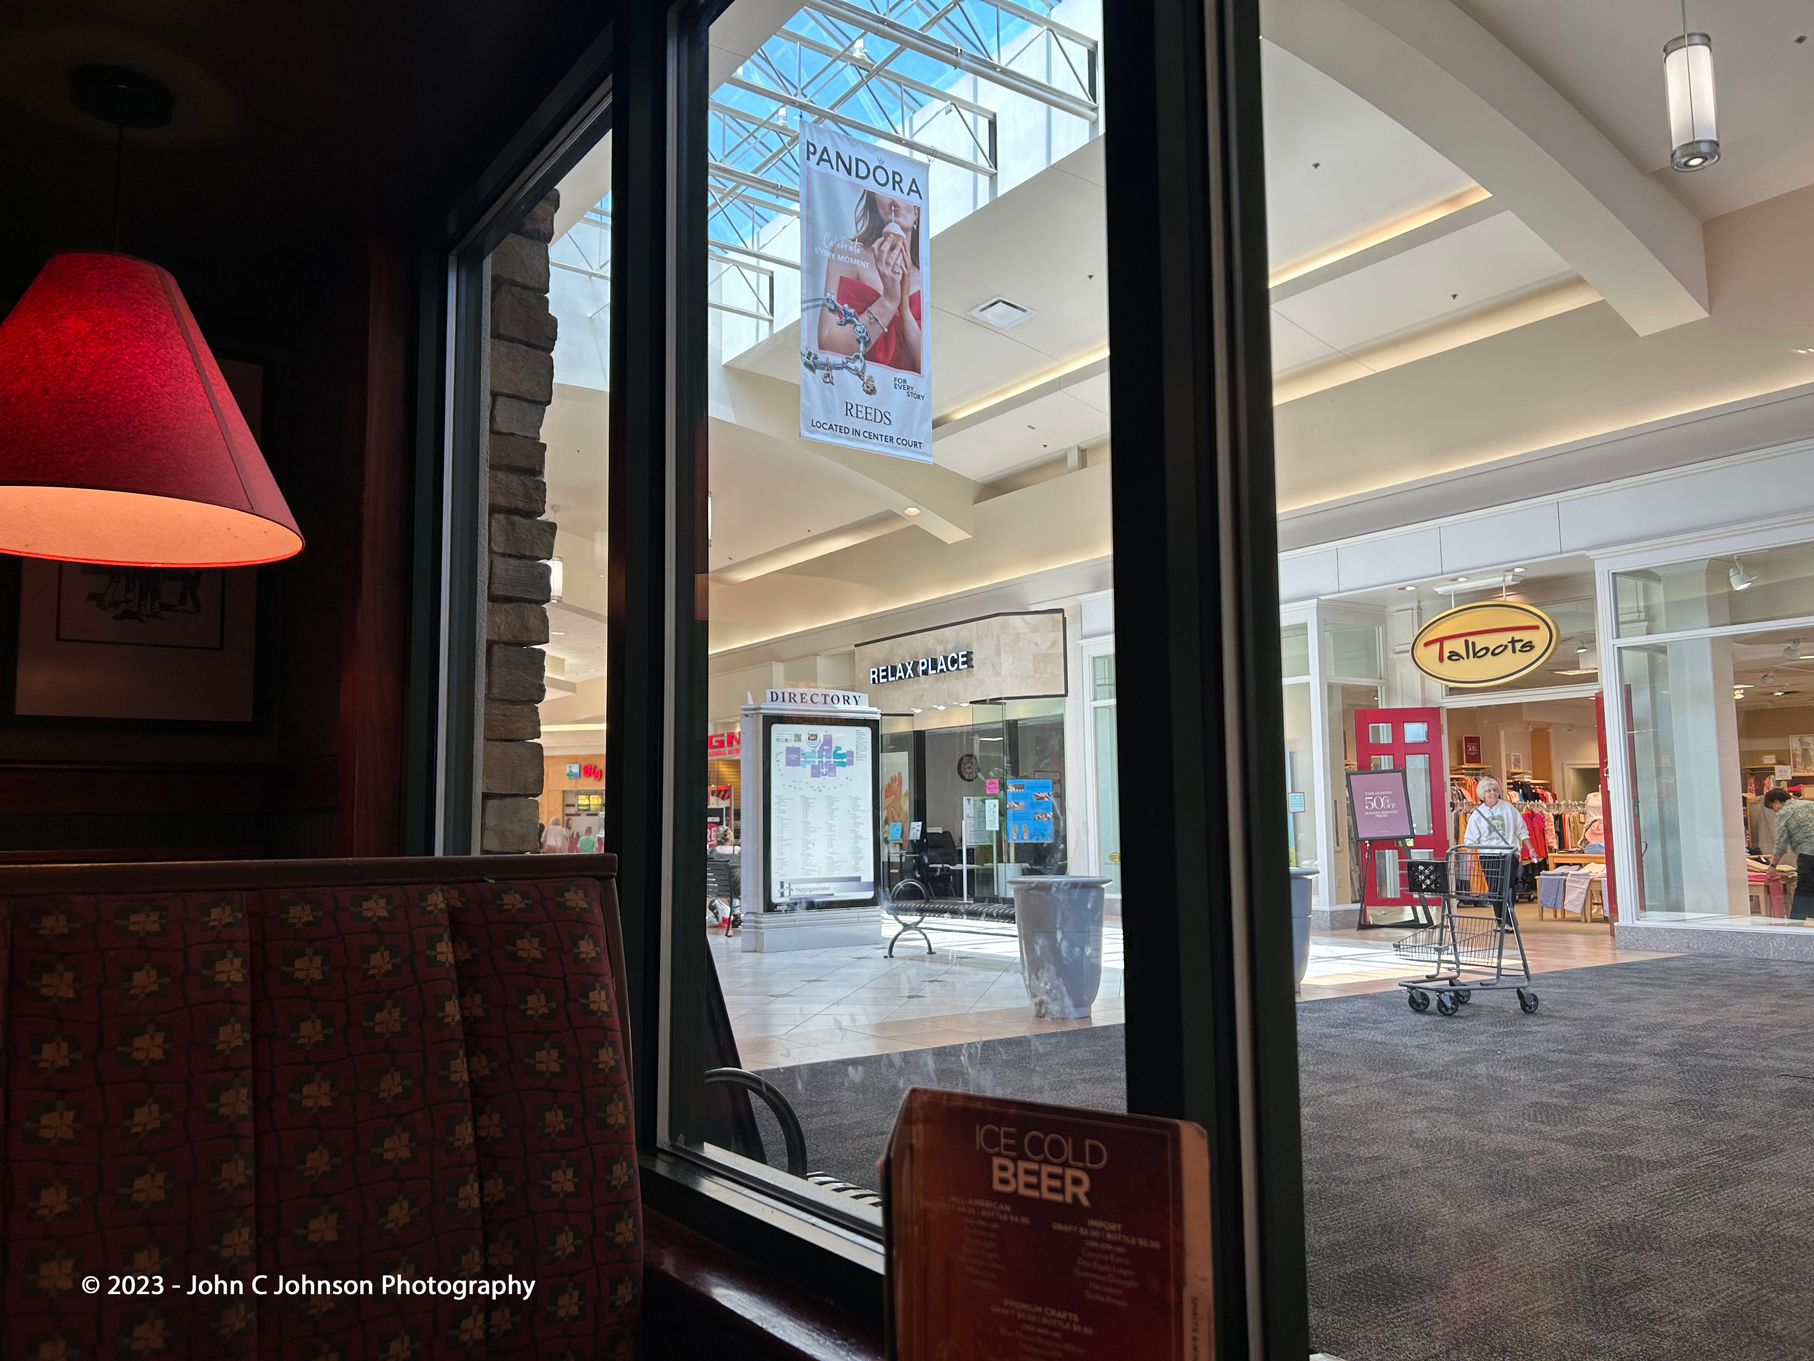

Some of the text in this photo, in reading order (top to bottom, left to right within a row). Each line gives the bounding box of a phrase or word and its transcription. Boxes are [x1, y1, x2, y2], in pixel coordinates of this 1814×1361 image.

[806, 139, 922, 200] PANDORA
[823, 232, 864, 254] Celebrate
[814, 246, 870, 269] EVERY MOMENT
[894, 377, 907, 385] FOR
[894, 383, 914, 392] EVERY
[906, 391, 925, 401] STORY
[845, 401, 892, 426] REEDS
[811, 419, 923, 450] LOCATED IN CENTER COURT
[1423, 625, 1540, 663] Talbots
[869, 650, 968, 685] RELAX PLACE
[770, 691, 861, 706] DIRECTORY
[583, 764, 602, 781] Big
[976, 1123, 1108, 1170] ICE COLD
[992, 1155, 1091, 1207] BEER
[1052, 1221, 1077, 1233] DRAFT
[1106, 1231, 1136, 1244] BOTTLE
[1087, 1218, 1122, 1232] IMPORT
[1044, 1307, 1079, 1323] CRAFTS
